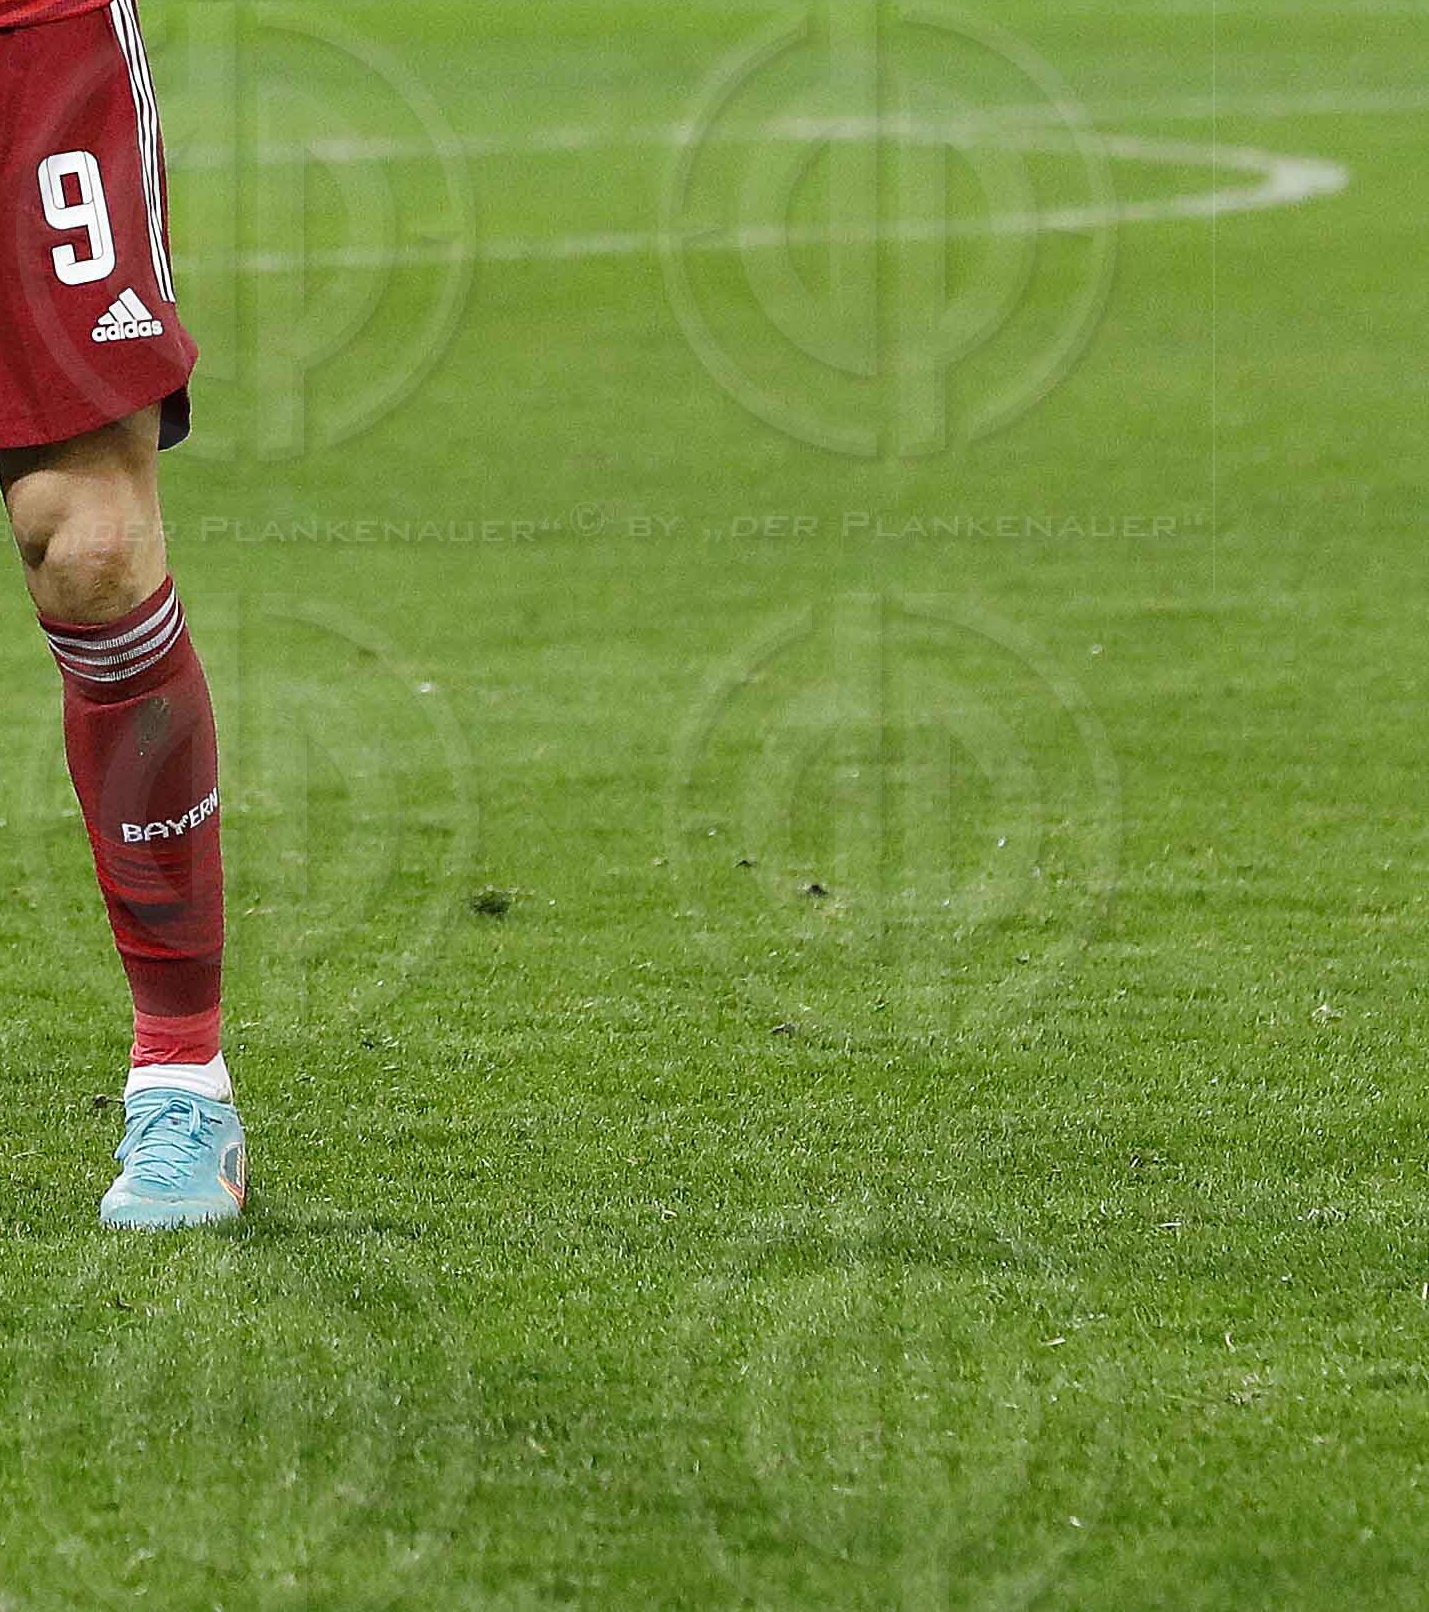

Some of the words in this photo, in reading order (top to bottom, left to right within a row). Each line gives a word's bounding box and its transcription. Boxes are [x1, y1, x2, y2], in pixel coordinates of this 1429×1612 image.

[37, 150, 116, 286] 9
[91, 319, 165, 343] adidas
[121, 787, 218, 843] BAYERN
